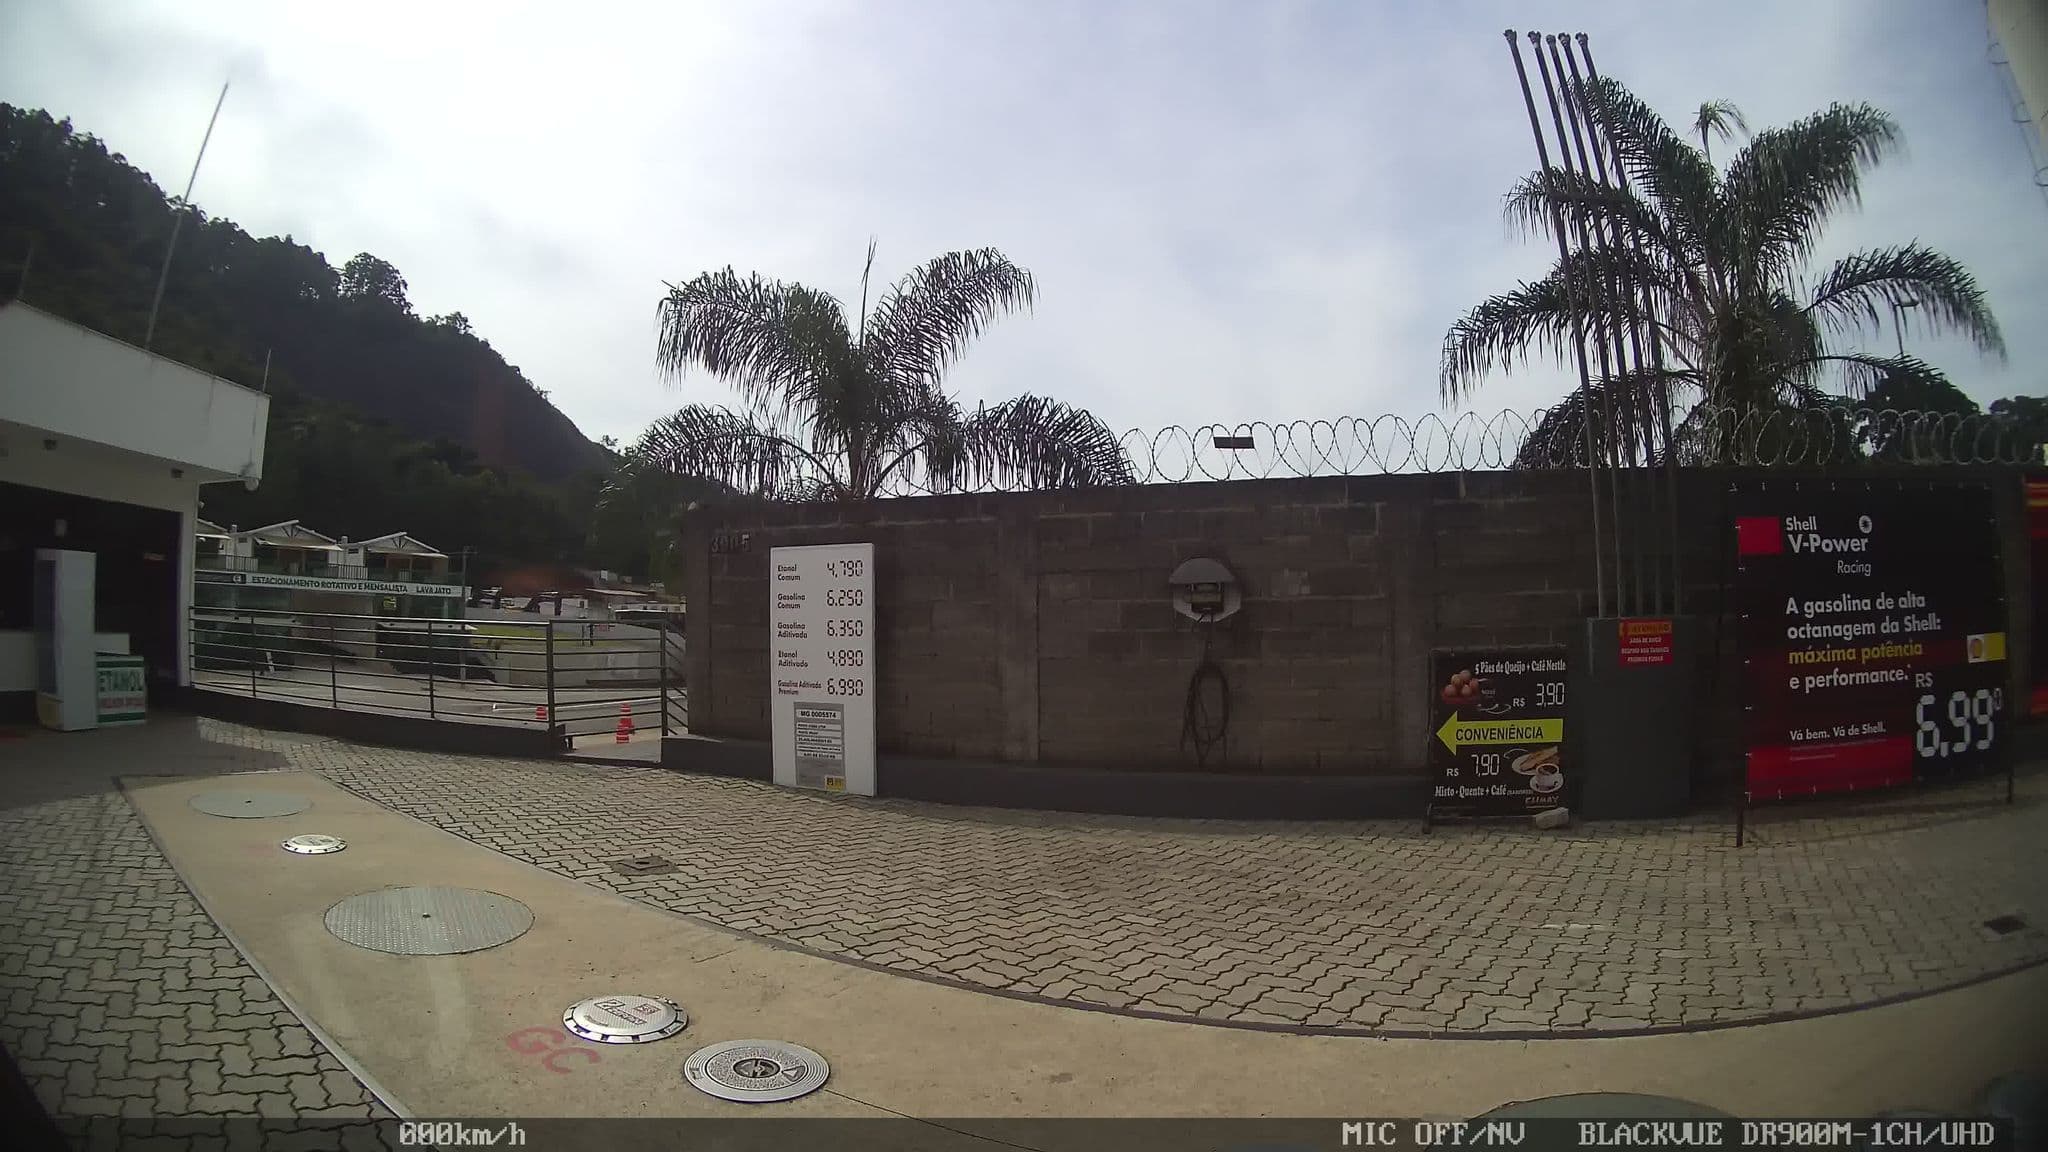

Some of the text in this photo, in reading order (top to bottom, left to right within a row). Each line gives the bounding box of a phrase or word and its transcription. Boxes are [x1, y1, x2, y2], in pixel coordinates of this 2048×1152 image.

[1785, 515, 1817, 531] Shell
[1787, 533, 1869, 553] V-Power
[777, 564, 797, 572] Etanol
[1837, 559, 1872, 577] Racing
[252, 576, 320, 588] ESTACIONAMENTO
[321, 581, 357, 590] ROTATIVO
[364, 582, 408, 593] MENSALISTA
[416, 585, 433, 594] LAVA
[434, 586, 451, 595] JATO
[777, 593, 806, 601] Gasolina
[1785, 590, 1926, 618] A gasolina de alta
[777, 622, 806, 630] Gasolina
[1787, 613, 1942, 640] octanagem da Shell:
[778, 650, 798, 658] Etanol
[1789, 640, 1923, 664] máxima potência
[1474, 662, 1479, 674] 5
[1480, 661, 1495, 673] Pães
[1495, 661, 1504, 673] de
[1504, 660, 1526, 675] Queijo
[1531, 659, 1546, 671] Café
[1789, 675, 1800, 690] e
[1915, 672, 1933, 688] R$
[1512, 682, 1565, 708] R$ 3,90
[1456, 724, 1544, 741] CONVENIÊNCIA
[1789, 721, 1886, 741] Vá bem. Vá de Shell.
[1446, 753, 1500, 777] R$ 7,90
[1491, 784, 1507, 796] Café
